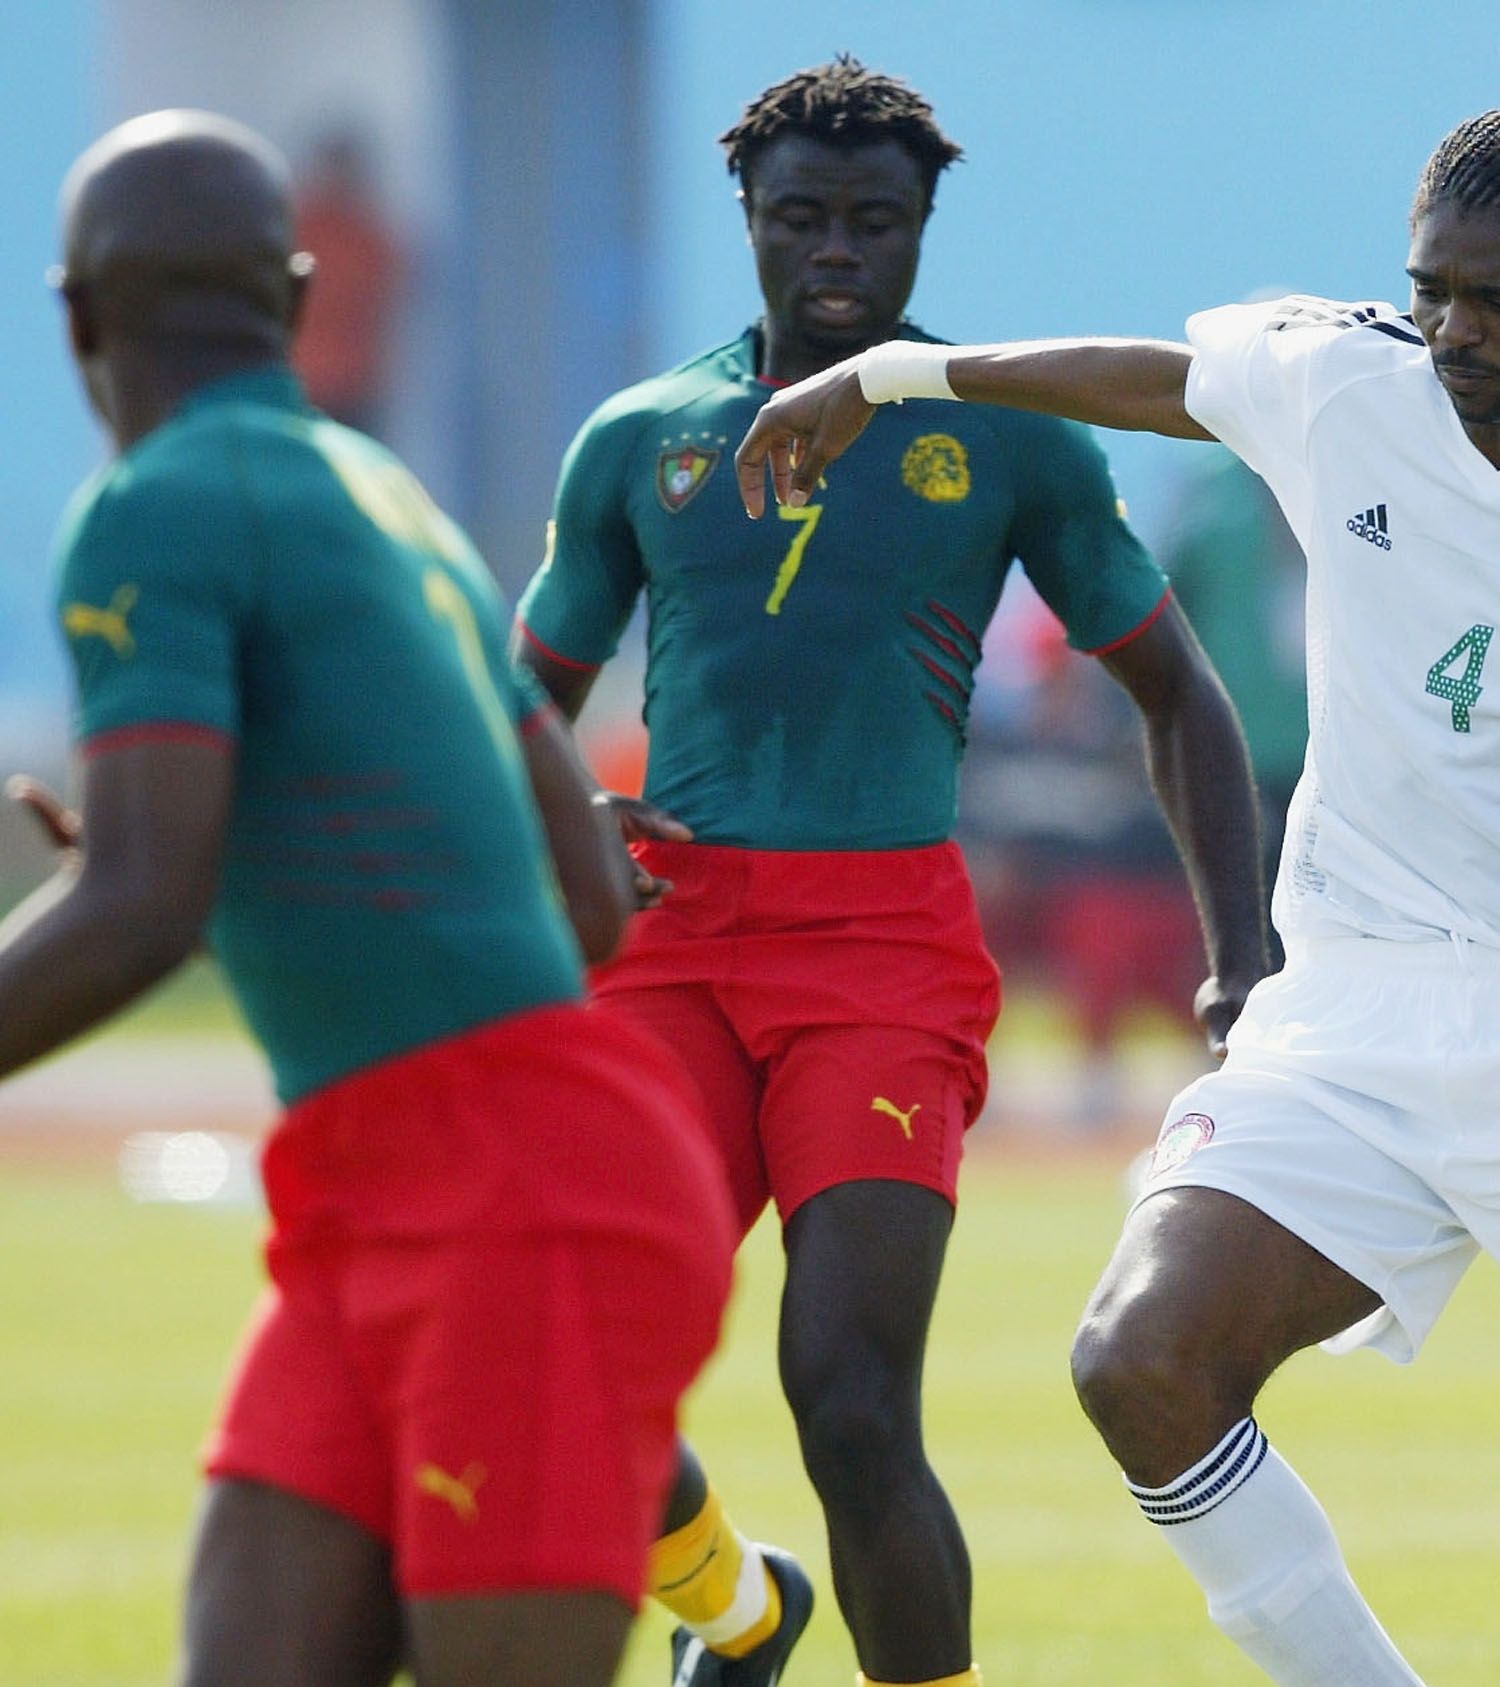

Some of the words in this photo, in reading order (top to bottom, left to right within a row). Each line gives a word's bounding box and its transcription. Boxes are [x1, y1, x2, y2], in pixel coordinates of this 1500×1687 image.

[764, 504, 824, 615] 7
[1346, 519, 1392, 551] adidas
[1425, 624, 1494, 733] 4
